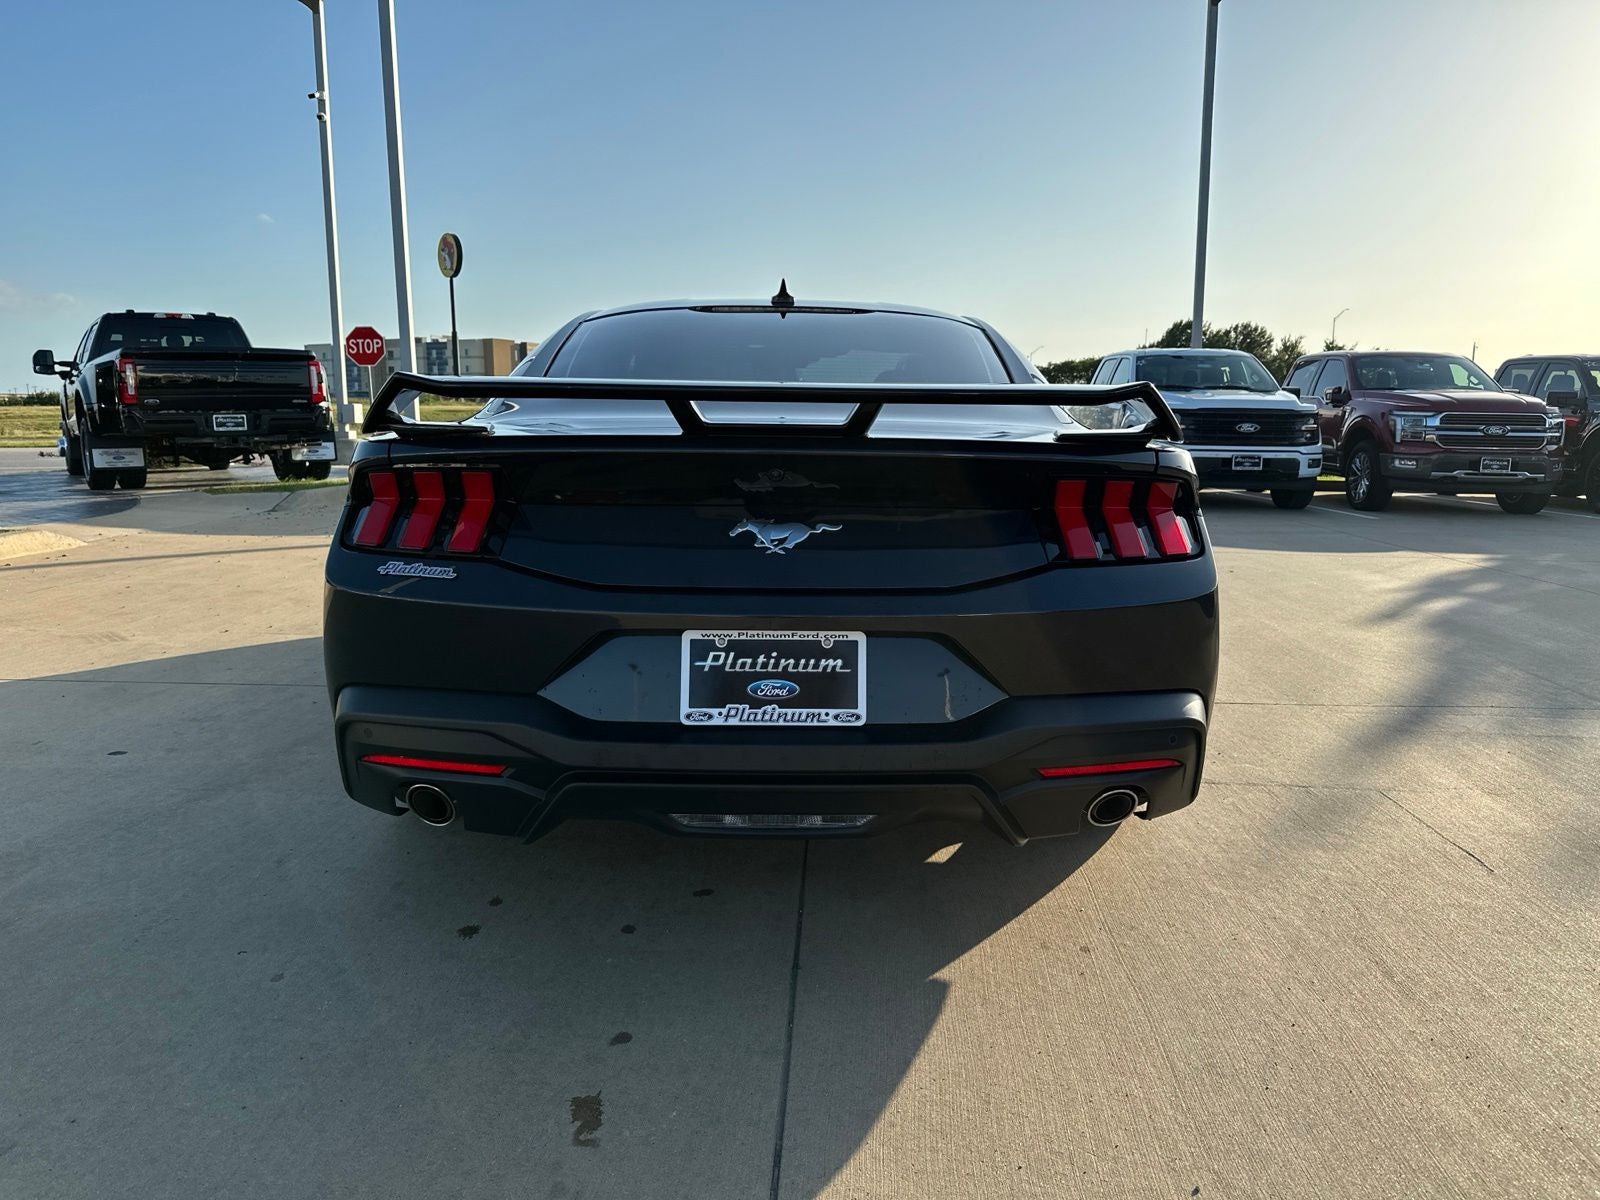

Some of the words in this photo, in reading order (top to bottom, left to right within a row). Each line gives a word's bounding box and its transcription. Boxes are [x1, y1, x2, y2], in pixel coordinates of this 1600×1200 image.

[349, 339, 382, 354] STOP
[377, 561, 457, 578] Platinum
[700, 631, 849, 640] www.PlatinumFord.com
[693, 651, 852, 673] Platinum
[757, 682, 791, 697] Ford
[723, 705, 831, 724] Platinum
